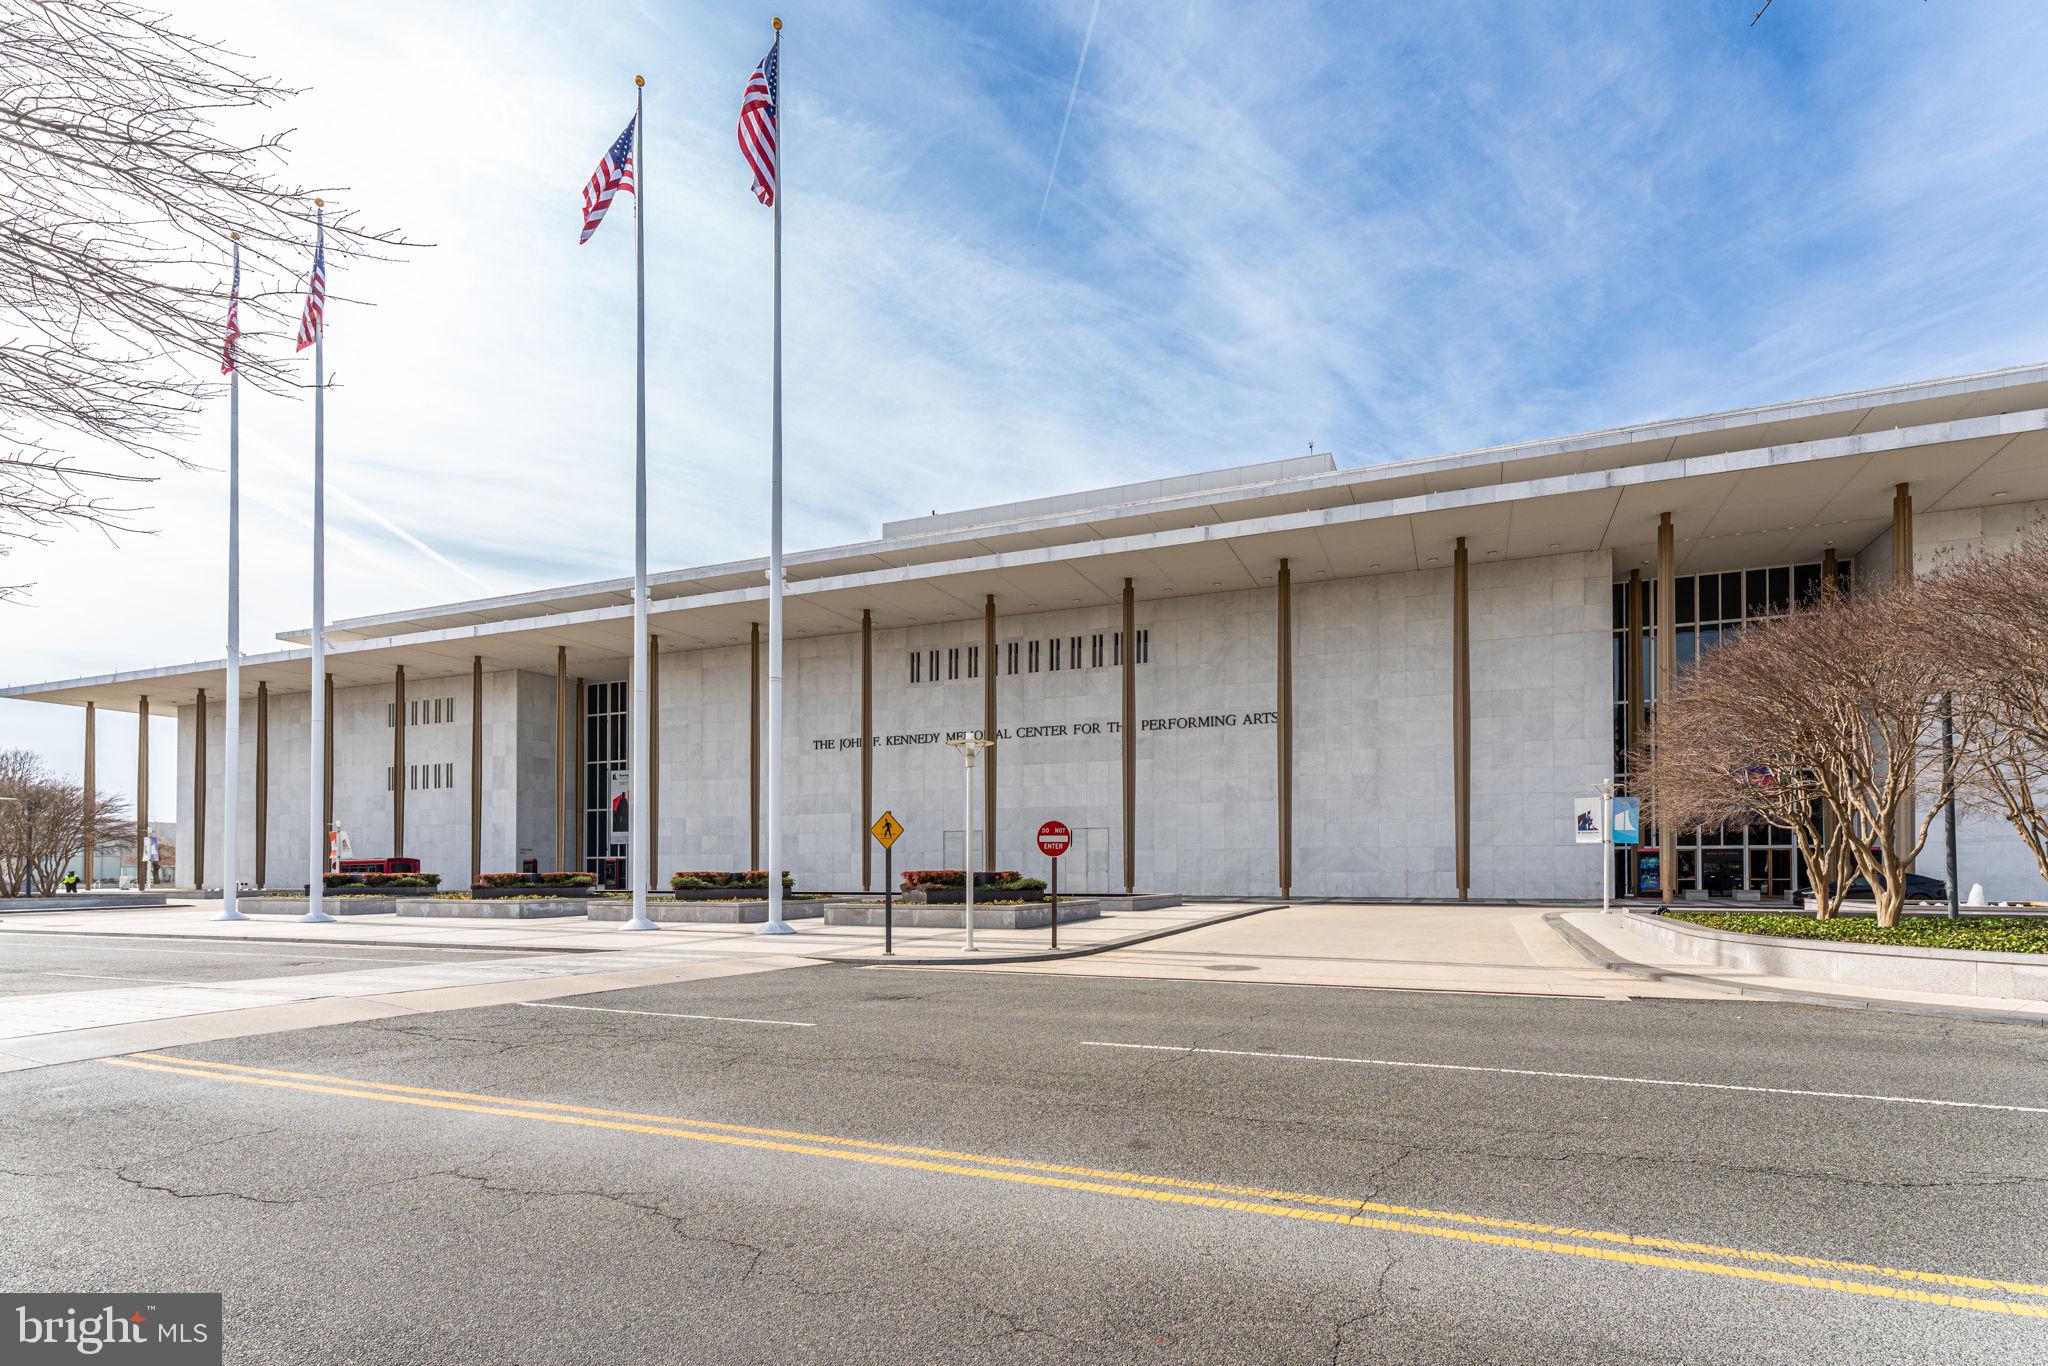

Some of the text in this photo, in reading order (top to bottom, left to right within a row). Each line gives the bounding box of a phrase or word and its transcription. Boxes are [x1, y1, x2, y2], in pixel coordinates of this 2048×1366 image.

[813, 711, 1279, 751] THE JOH F. KENNEDY MEOAL CENTER FOR TH PERFORMING ARTS
[1043, 842, 1064, 850] ENTER
